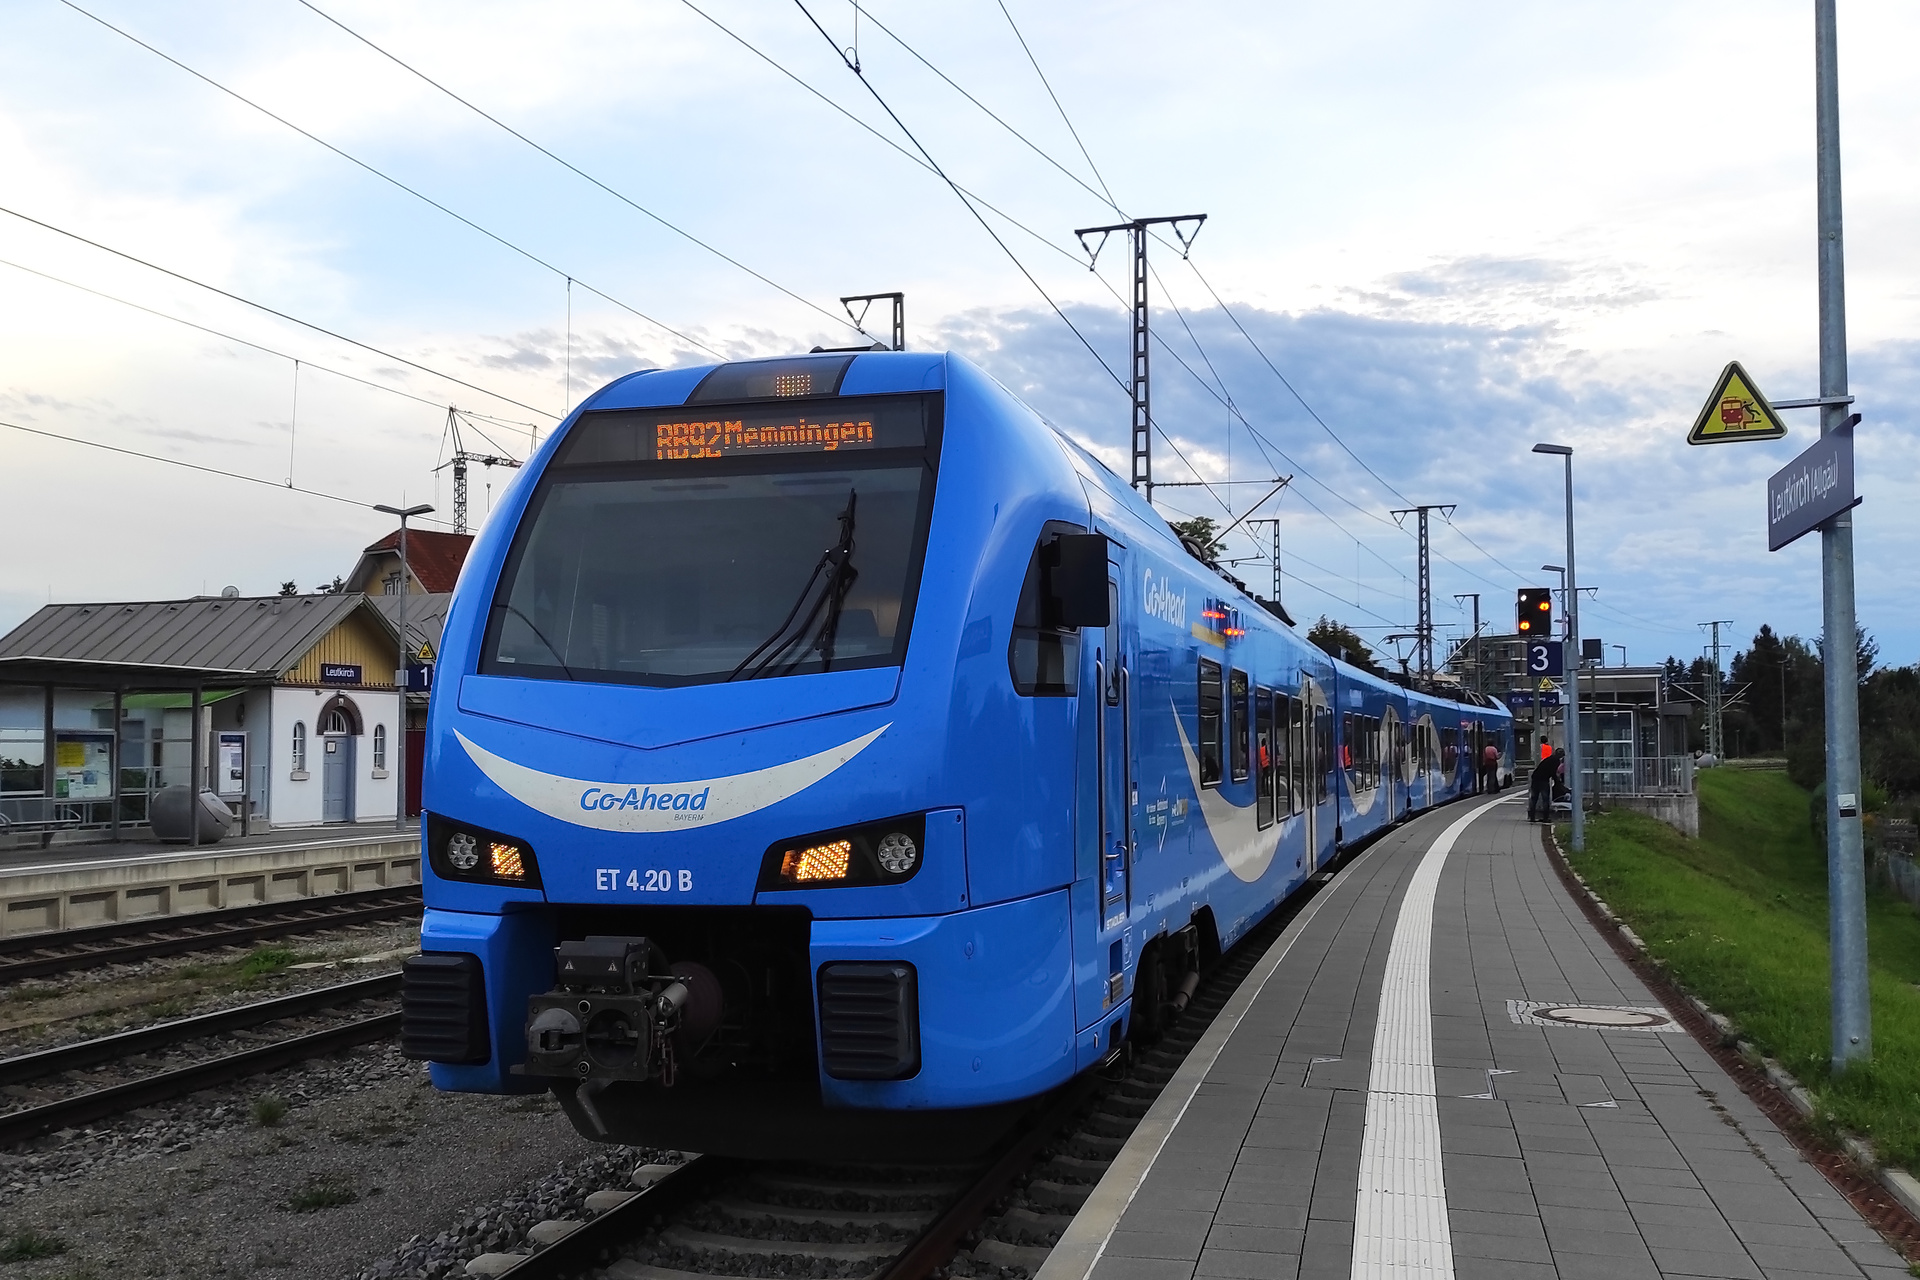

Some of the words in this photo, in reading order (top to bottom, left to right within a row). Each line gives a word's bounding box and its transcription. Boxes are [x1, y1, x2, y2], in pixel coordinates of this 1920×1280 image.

[657, 421, 722, 460] RB92
[724, 419, 873, 450] Memmingen
[1772, 465, 1810, 524] Leutkirch
[1811, 450, 1838, 502] (Allgäu)
[1143, 567, 1186, 629] Go-Ahead
[1531, 645, 1549, 671] 3
[325, 666, 355, 678] Leutkirch
[420, 666, 428, 687] 1
[580, 786, 710, 811] Go-Ahead
[674, 813, 704, 821] BAYERN
[596, 869, 620, 891] ET
[626, 869, 671, 892] 4.20
[678, 869, 693, 892] B
